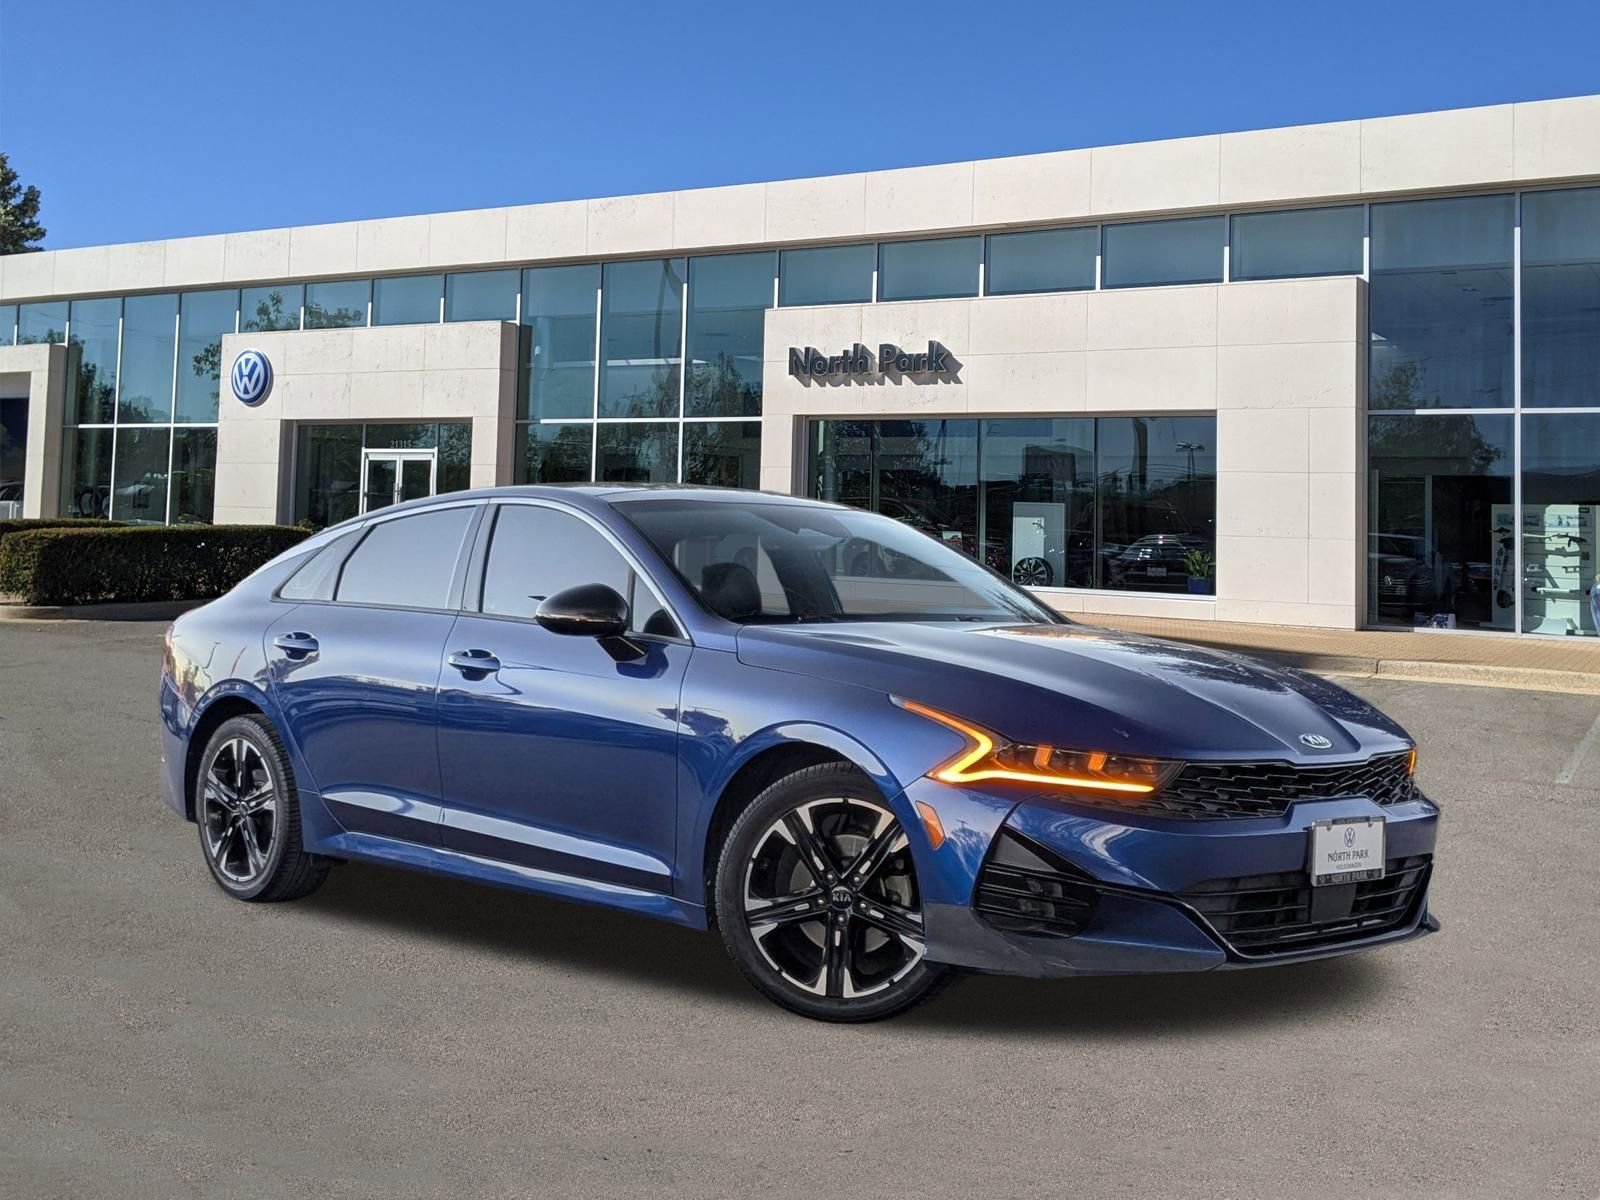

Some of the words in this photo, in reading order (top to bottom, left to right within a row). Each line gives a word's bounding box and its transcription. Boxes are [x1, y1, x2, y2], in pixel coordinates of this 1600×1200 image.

[788, 342, 872, 377] North
[878, 339, 950, 374] Park
[232, 351, 267, 402] VW
[1301, 734, 1331, 747] KIA
[1327, 850, 1351, 862] NORTH
[1352, 849, 1370, 860] PARK
[832, 892, 852, 902] KIA
